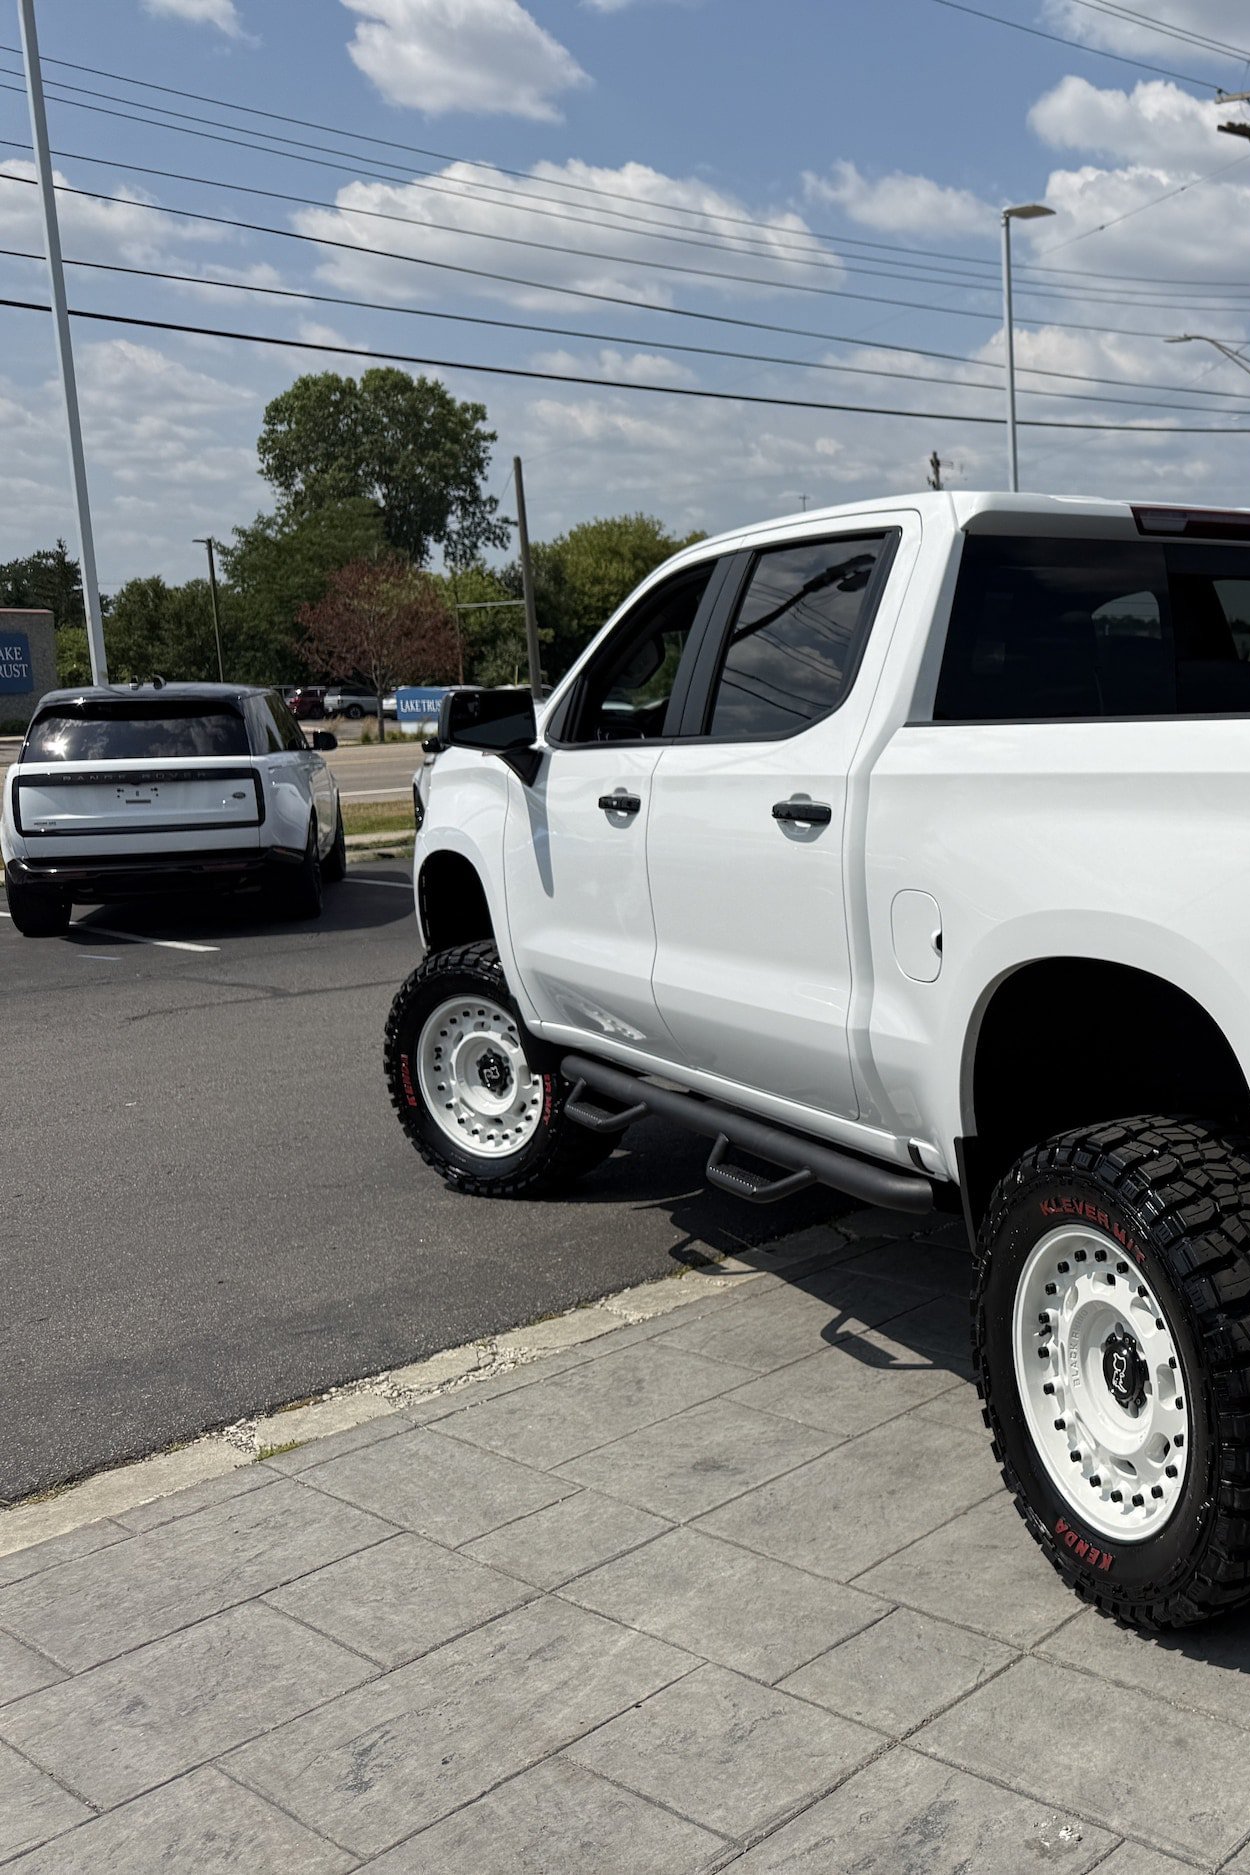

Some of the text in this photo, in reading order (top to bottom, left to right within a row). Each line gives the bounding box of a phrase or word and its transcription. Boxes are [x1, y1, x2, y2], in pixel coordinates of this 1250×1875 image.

[400, 699, 421, 713] LAKE
[1040, 1196, 1110, 1233] KLEVER
[1055, 1518, 1114, 1572] KENDA
